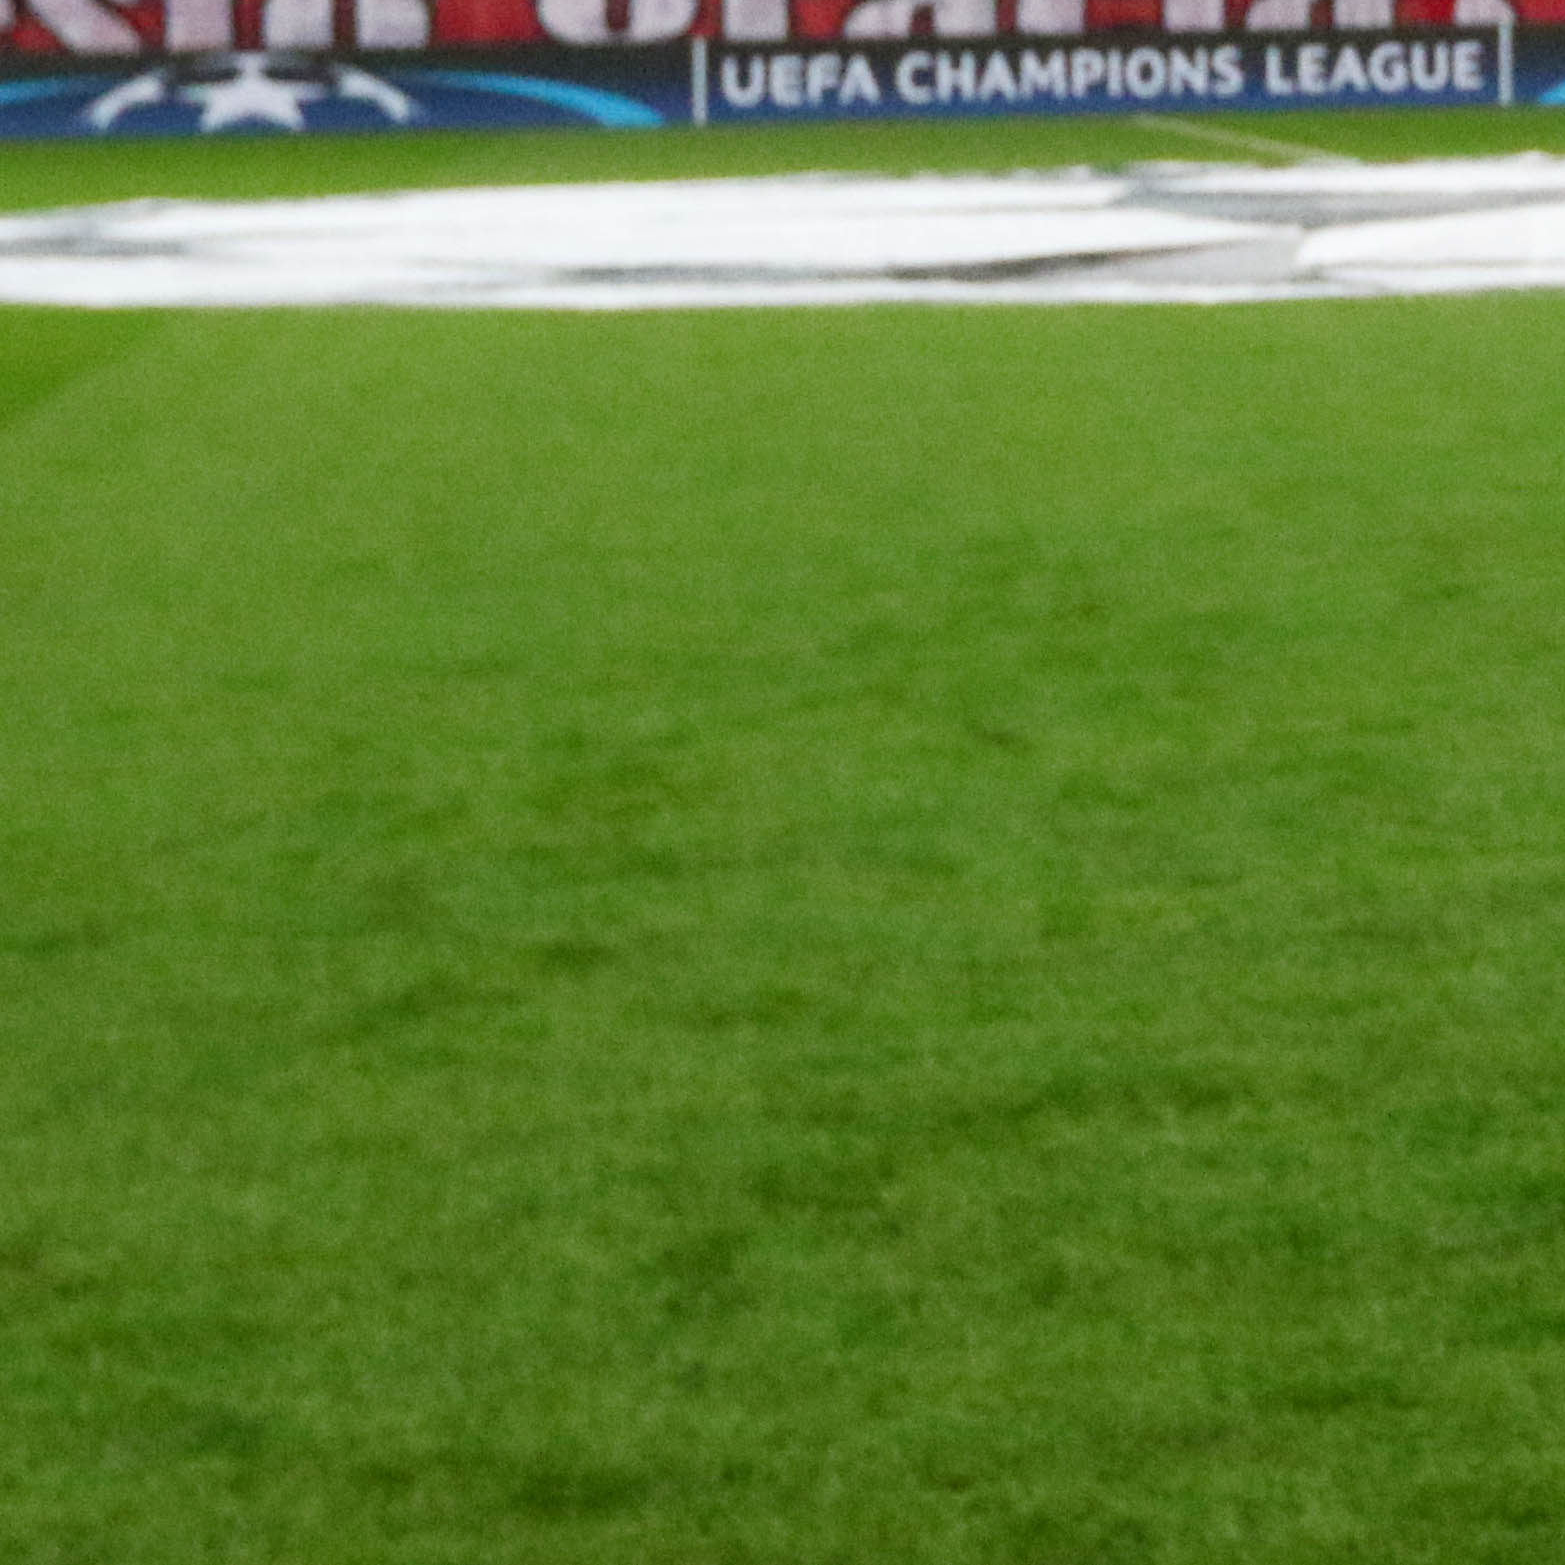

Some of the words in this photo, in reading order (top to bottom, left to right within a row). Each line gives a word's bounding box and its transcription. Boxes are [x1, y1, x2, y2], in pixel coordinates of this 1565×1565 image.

[719, 52, 882, 110] UEFA
[894, 44, 1245, 105] CHAMPIONS
[1265, 39, 1486, 97] LEAGUE
